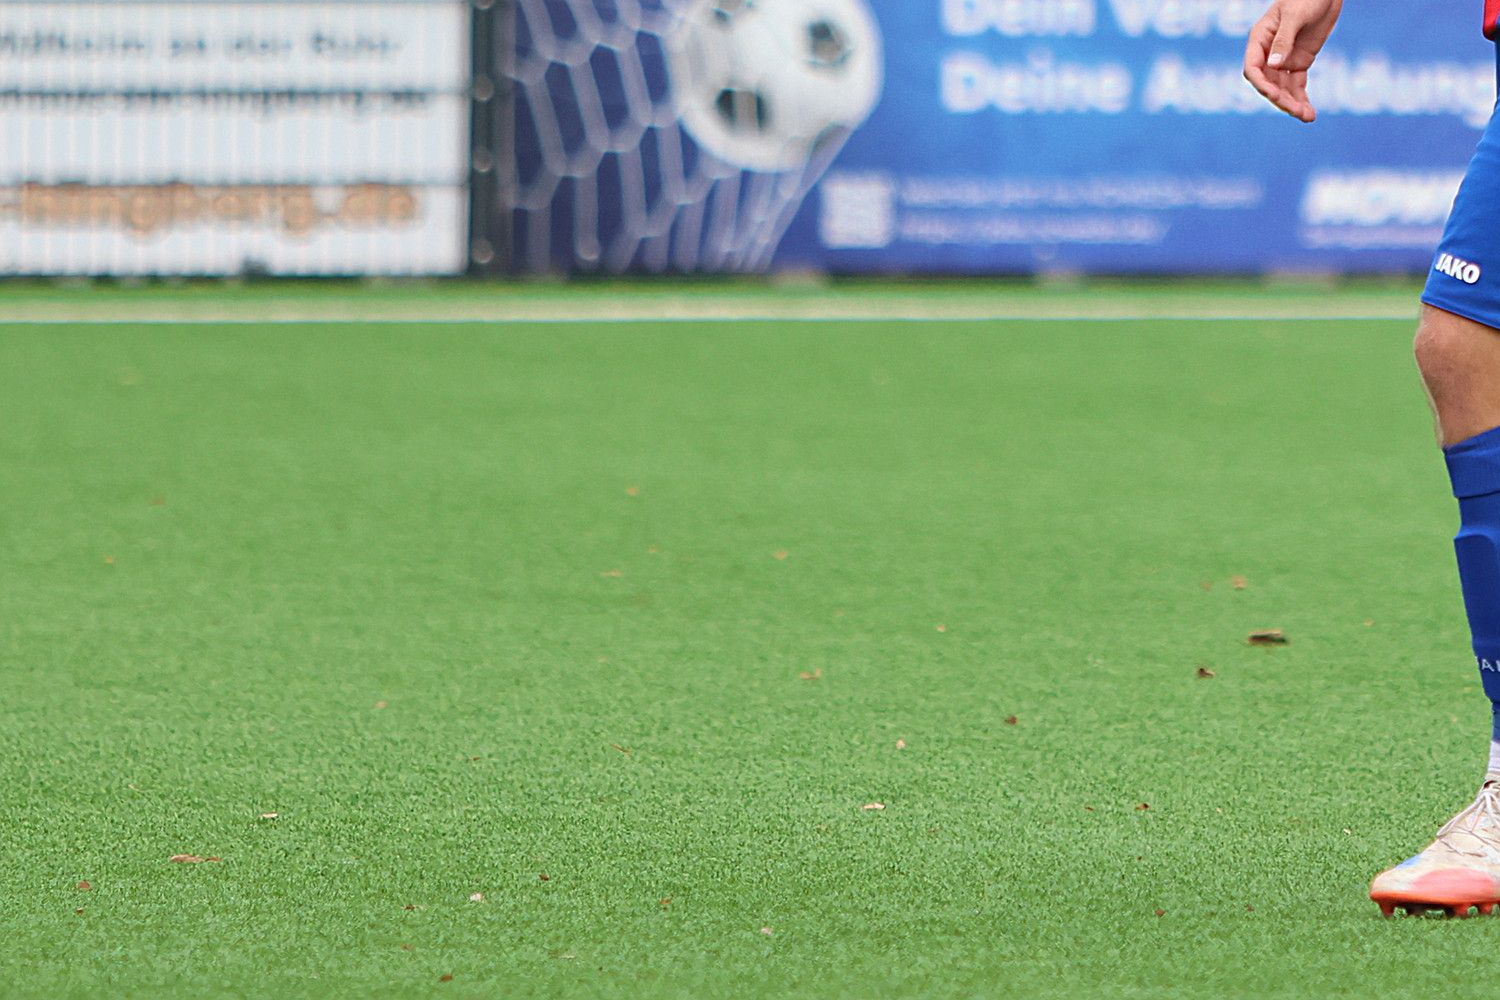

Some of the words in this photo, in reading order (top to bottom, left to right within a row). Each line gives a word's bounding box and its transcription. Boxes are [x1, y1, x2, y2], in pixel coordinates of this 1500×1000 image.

[941, 46, 1133, 114] Deine
[1144, 51, 1497, 128] Ausildung
[1435, 253, 1480, 284] JAKO
